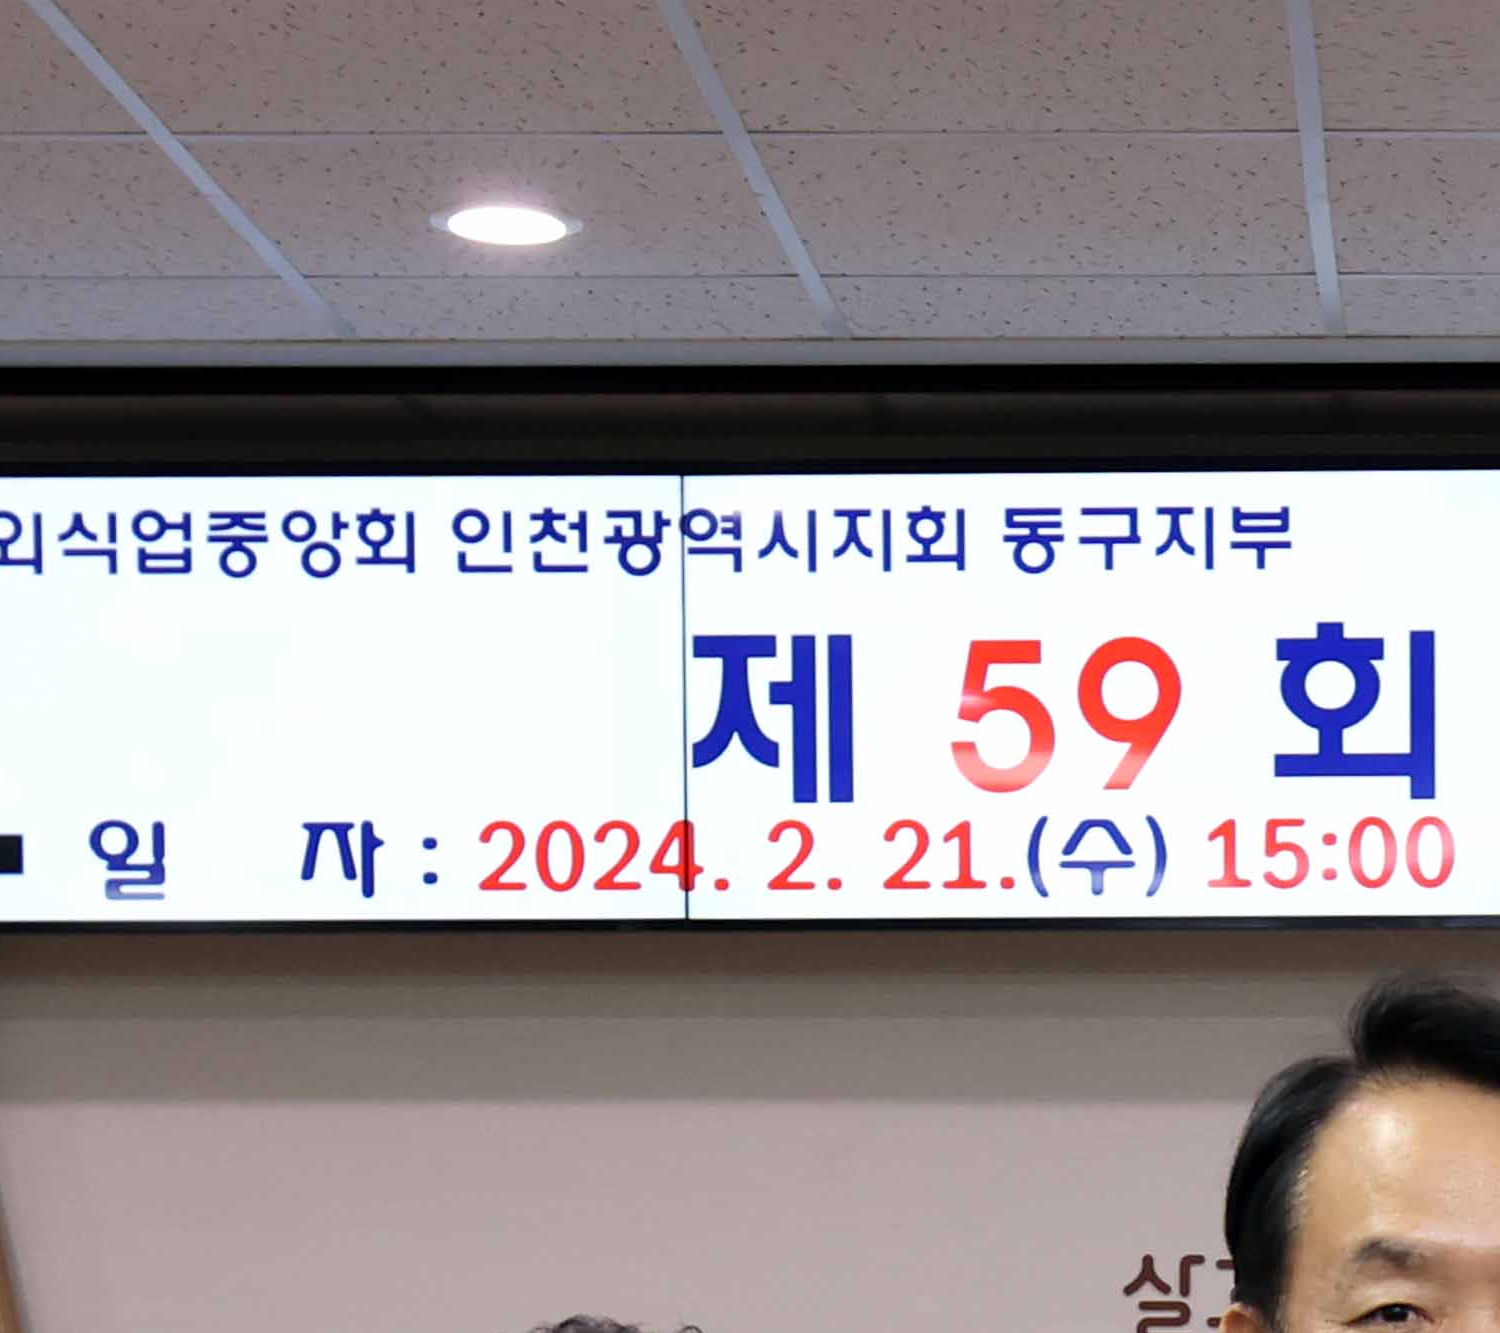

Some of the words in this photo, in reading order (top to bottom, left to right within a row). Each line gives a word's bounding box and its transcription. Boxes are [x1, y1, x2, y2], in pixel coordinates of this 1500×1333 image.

[452, 505, 970, 576] 인천광역시지회
[1002, 505, 1292, 575] 동구지부
[477, 819, 730, 894] 2024.
[767, 819, 843, 891] 2.
[1207, 815, 1455, 890] 15:00
